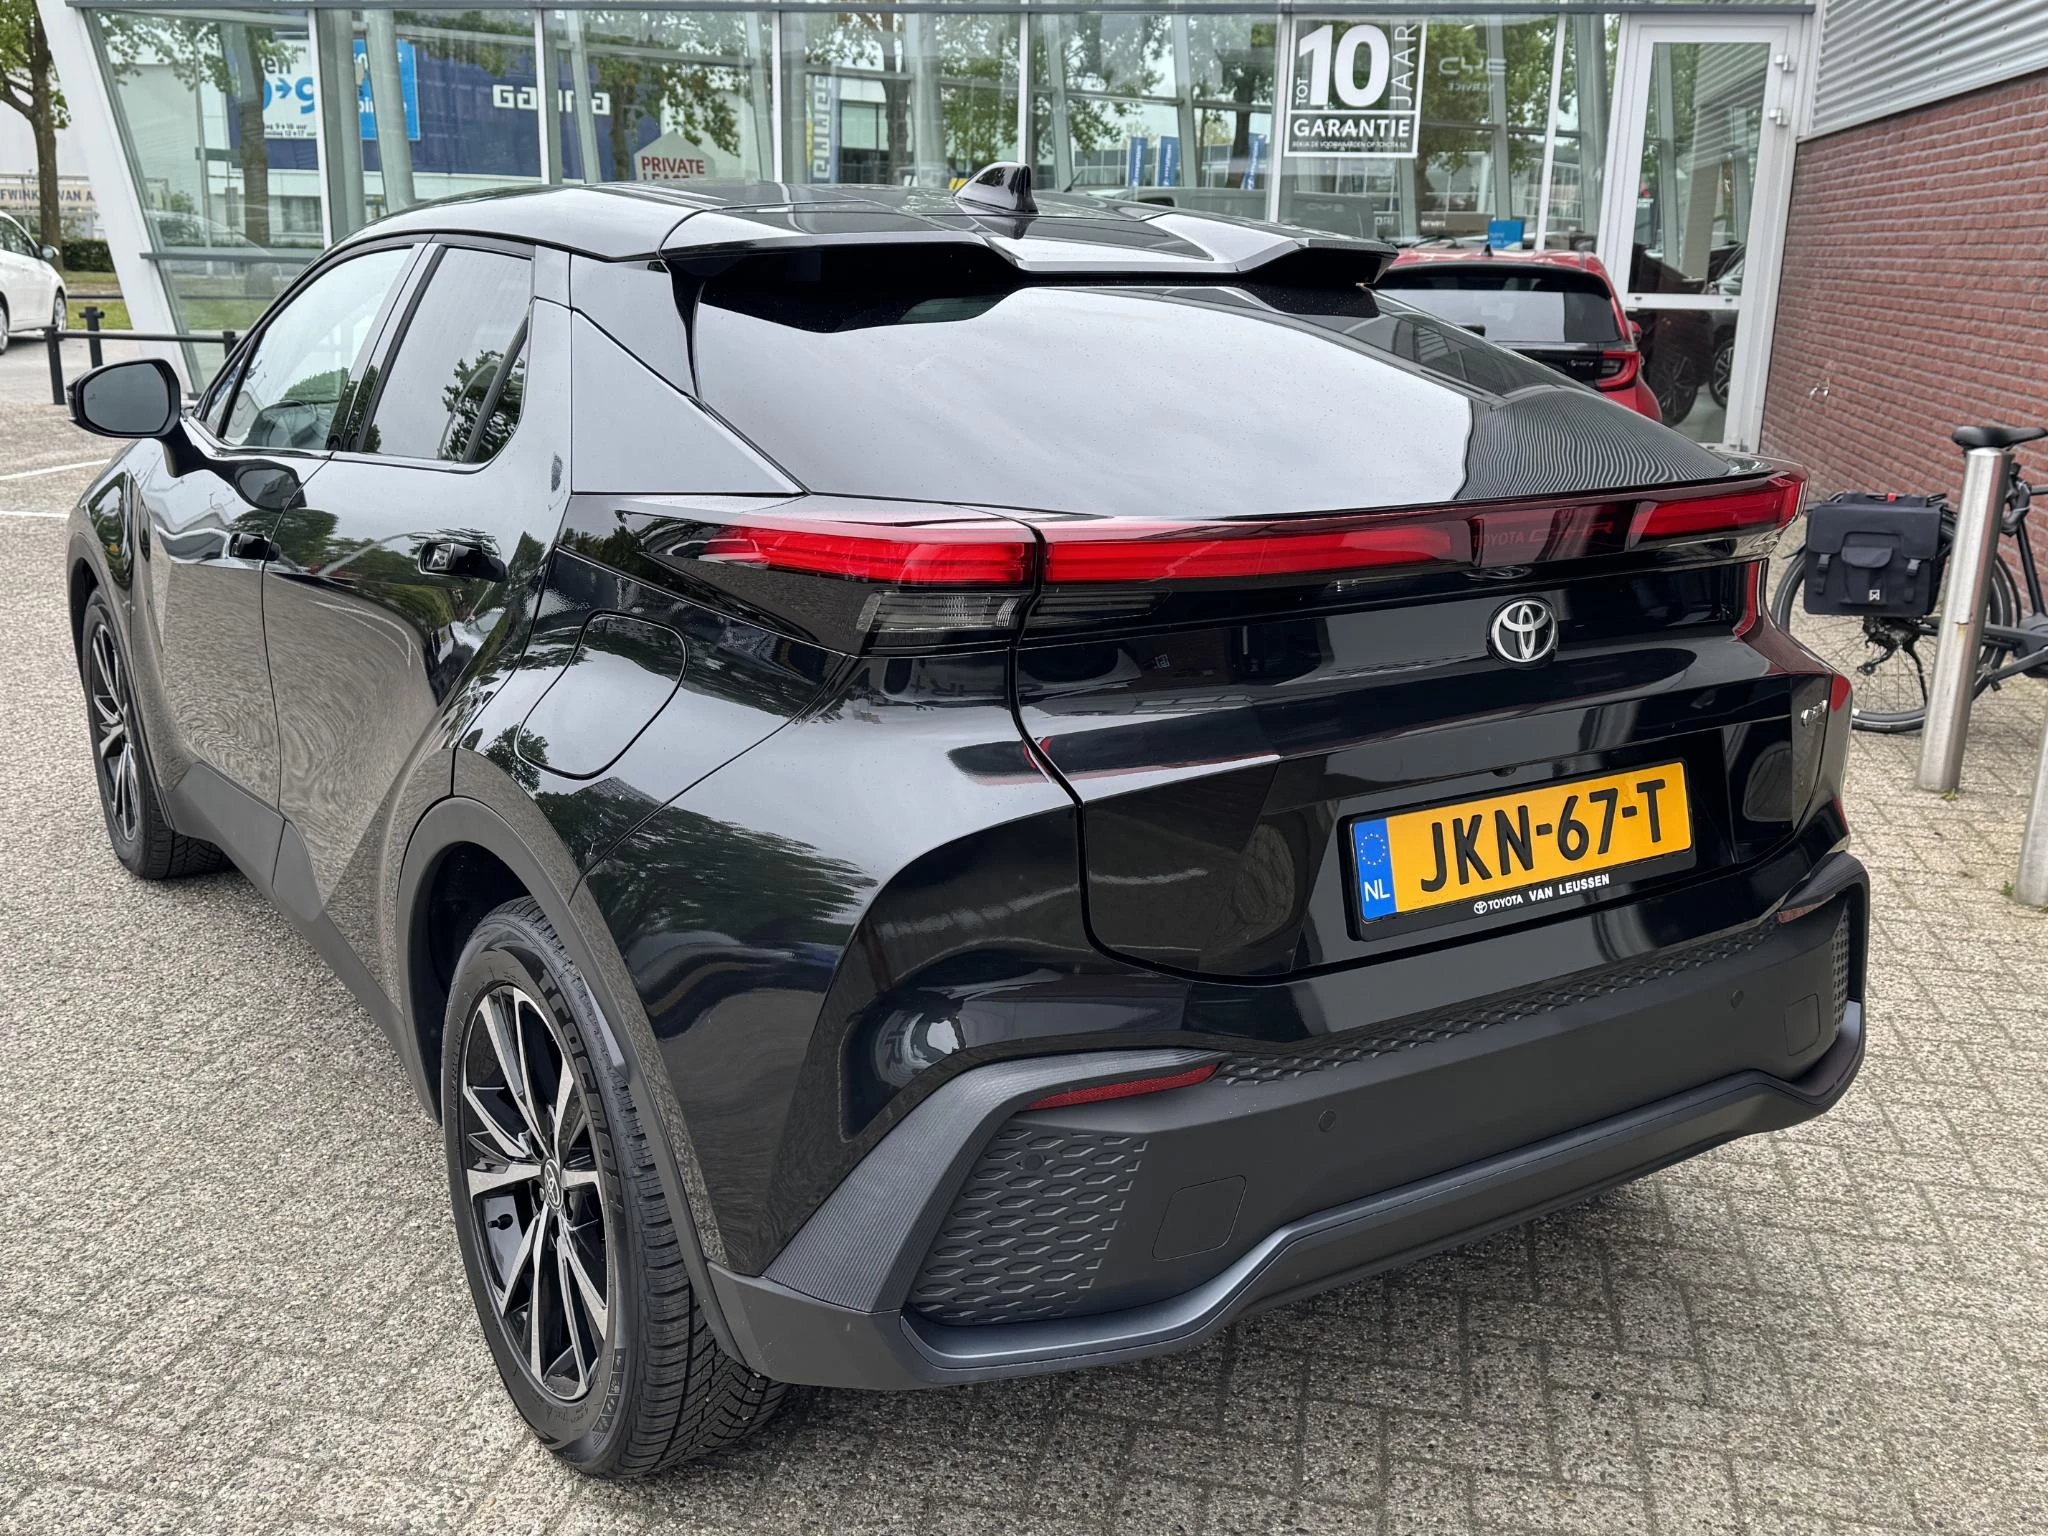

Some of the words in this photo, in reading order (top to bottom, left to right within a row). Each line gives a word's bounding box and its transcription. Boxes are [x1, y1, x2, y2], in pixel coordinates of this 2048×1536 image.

[1298, 24, 1391, 108] 10
[1389, 23, 1418, 108] JAAR
[1295, 77, 1309, 106] TOT
[1293, 118, 1411, 137] GARANTIE
[641, 156, 705, 175] PRIVATE
[1420, 778, 1667, 893] JKN-67-T
[1363, 879, 1391, 903] NL
[1487, 894, 1524, 910] TOYOTA
[1528, 886, 1554, 902] VAN
[1558, 873, 1611, 896] LEUSSEN
